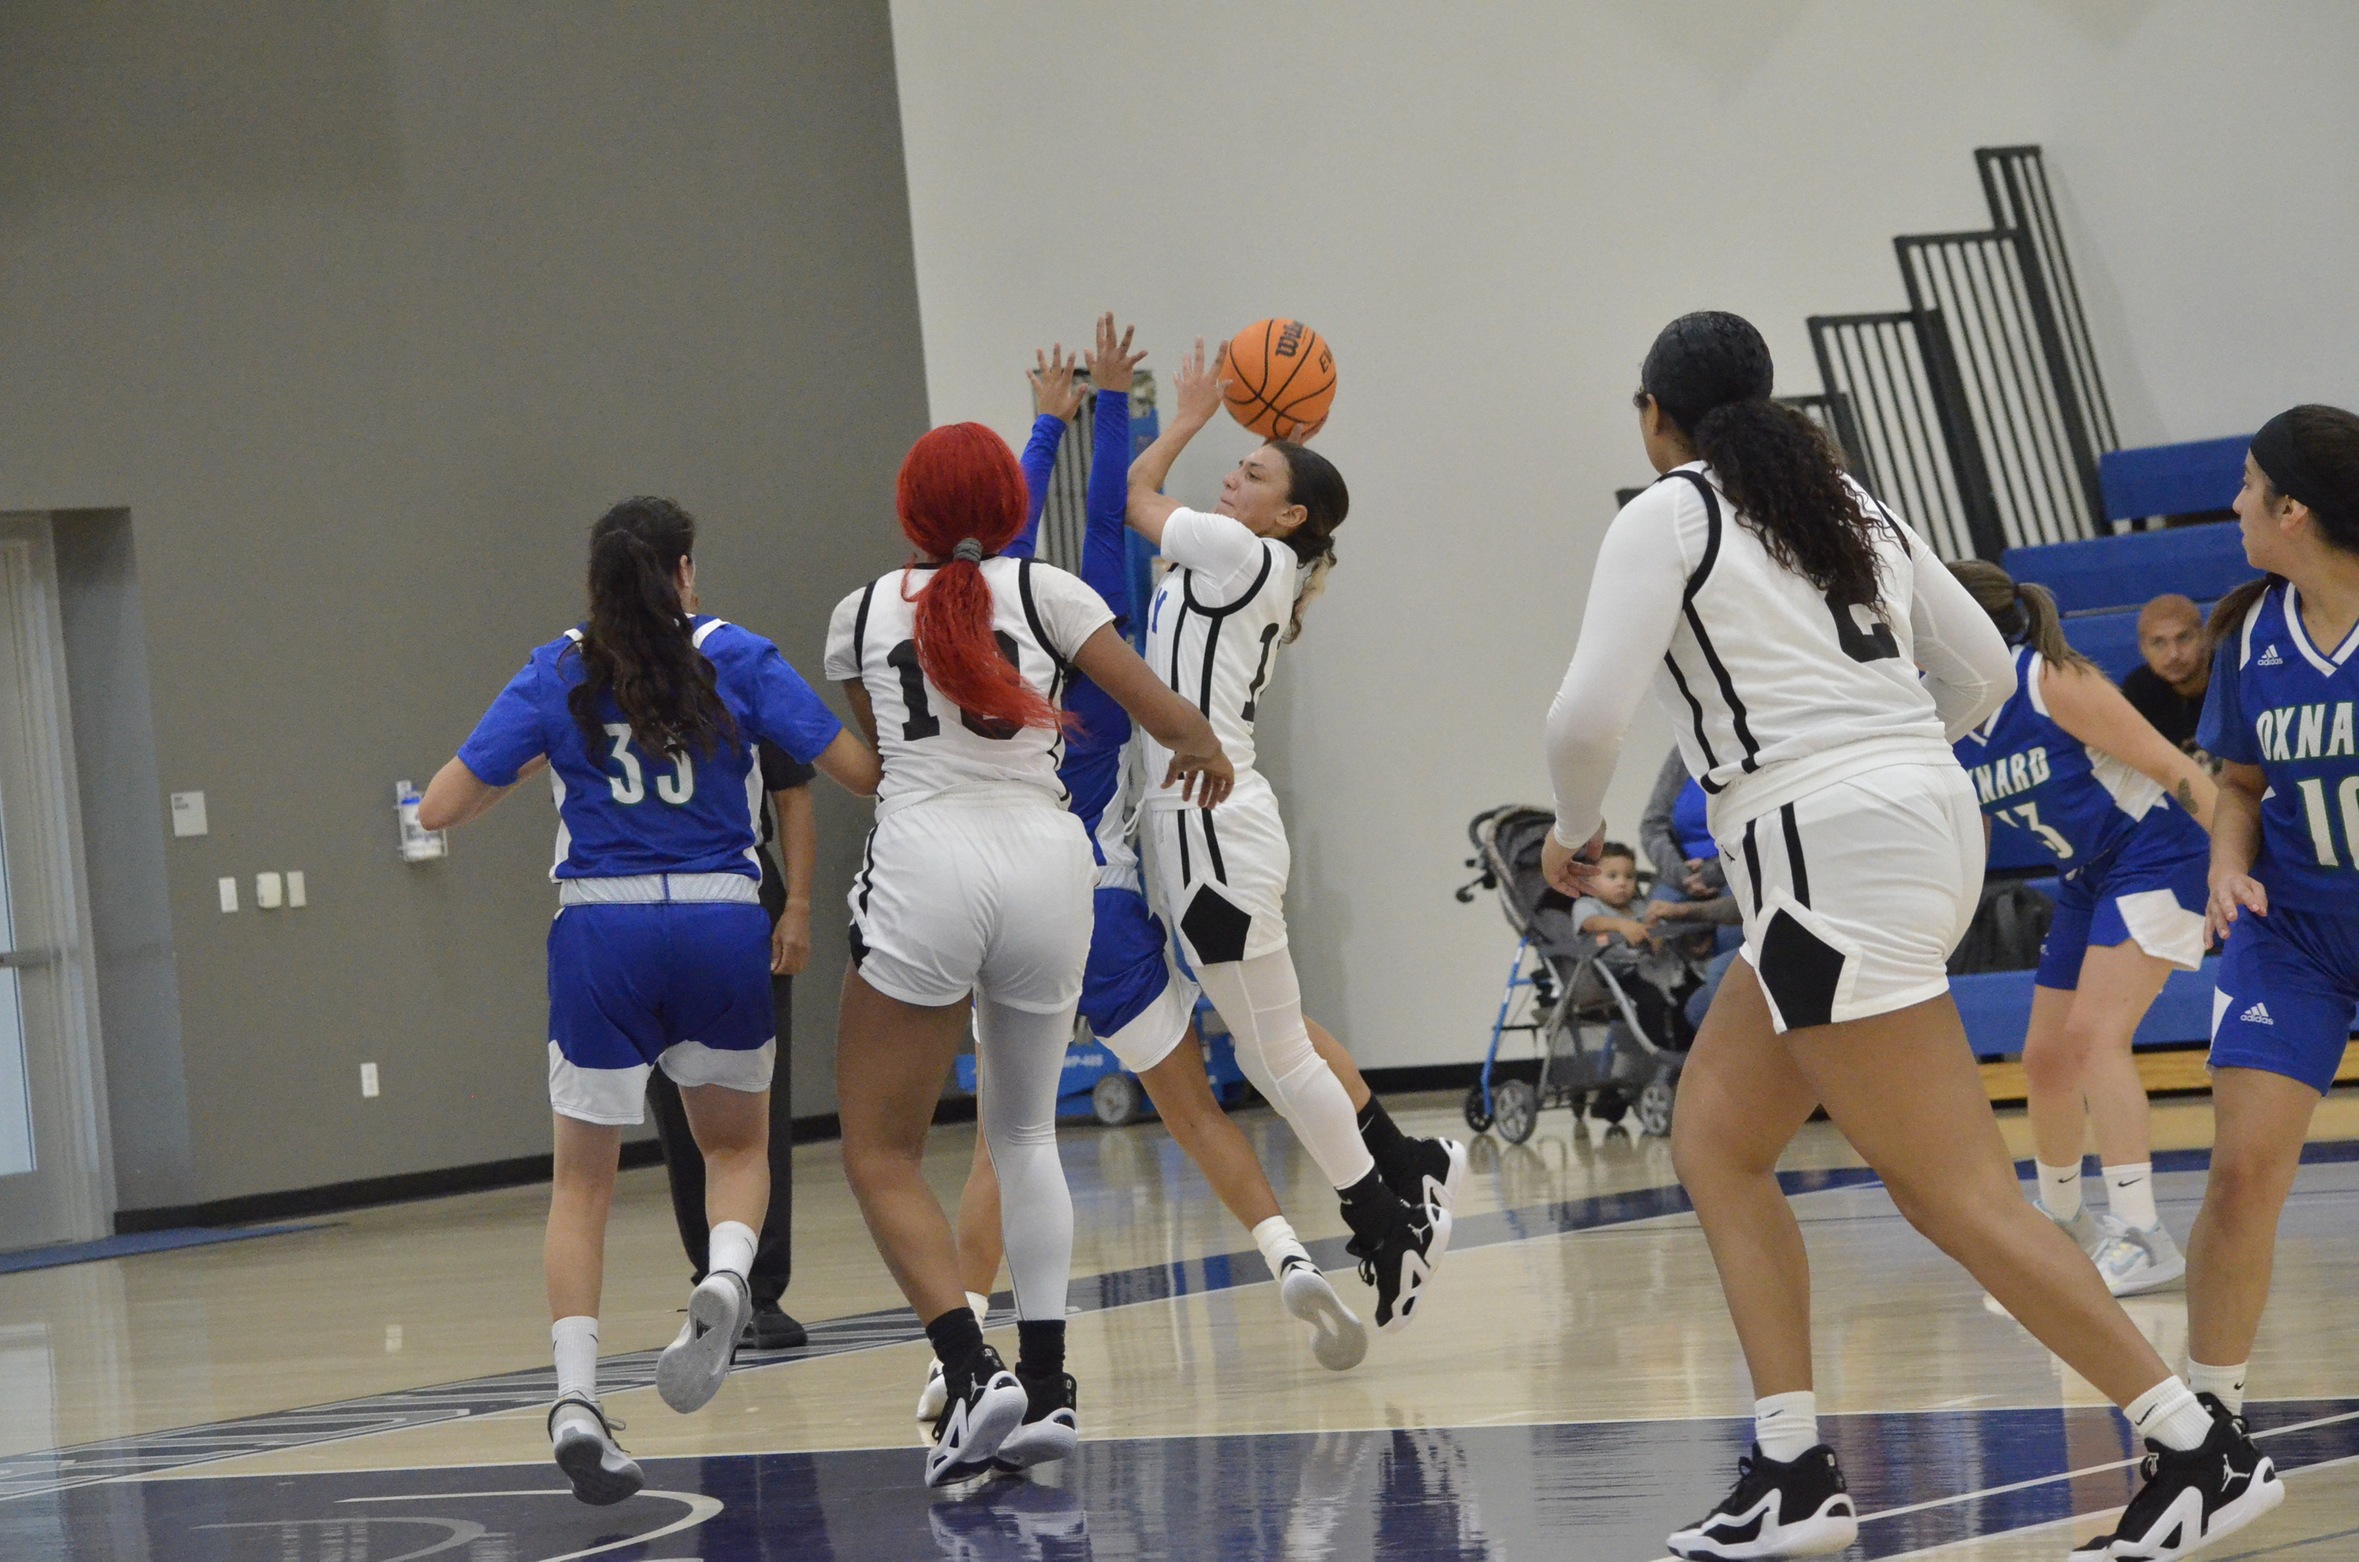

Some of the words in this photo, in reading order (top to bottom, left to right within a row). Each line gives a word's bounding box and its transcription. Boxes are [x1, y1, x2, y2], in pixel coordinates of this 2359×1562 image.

[2257, 657, 2284, 666] adidas
[2256, 701, 2355, 761] OXNA
[1995, 801, 2074, 859] 3
[2240, 1013, 2274, 1026] adidas
